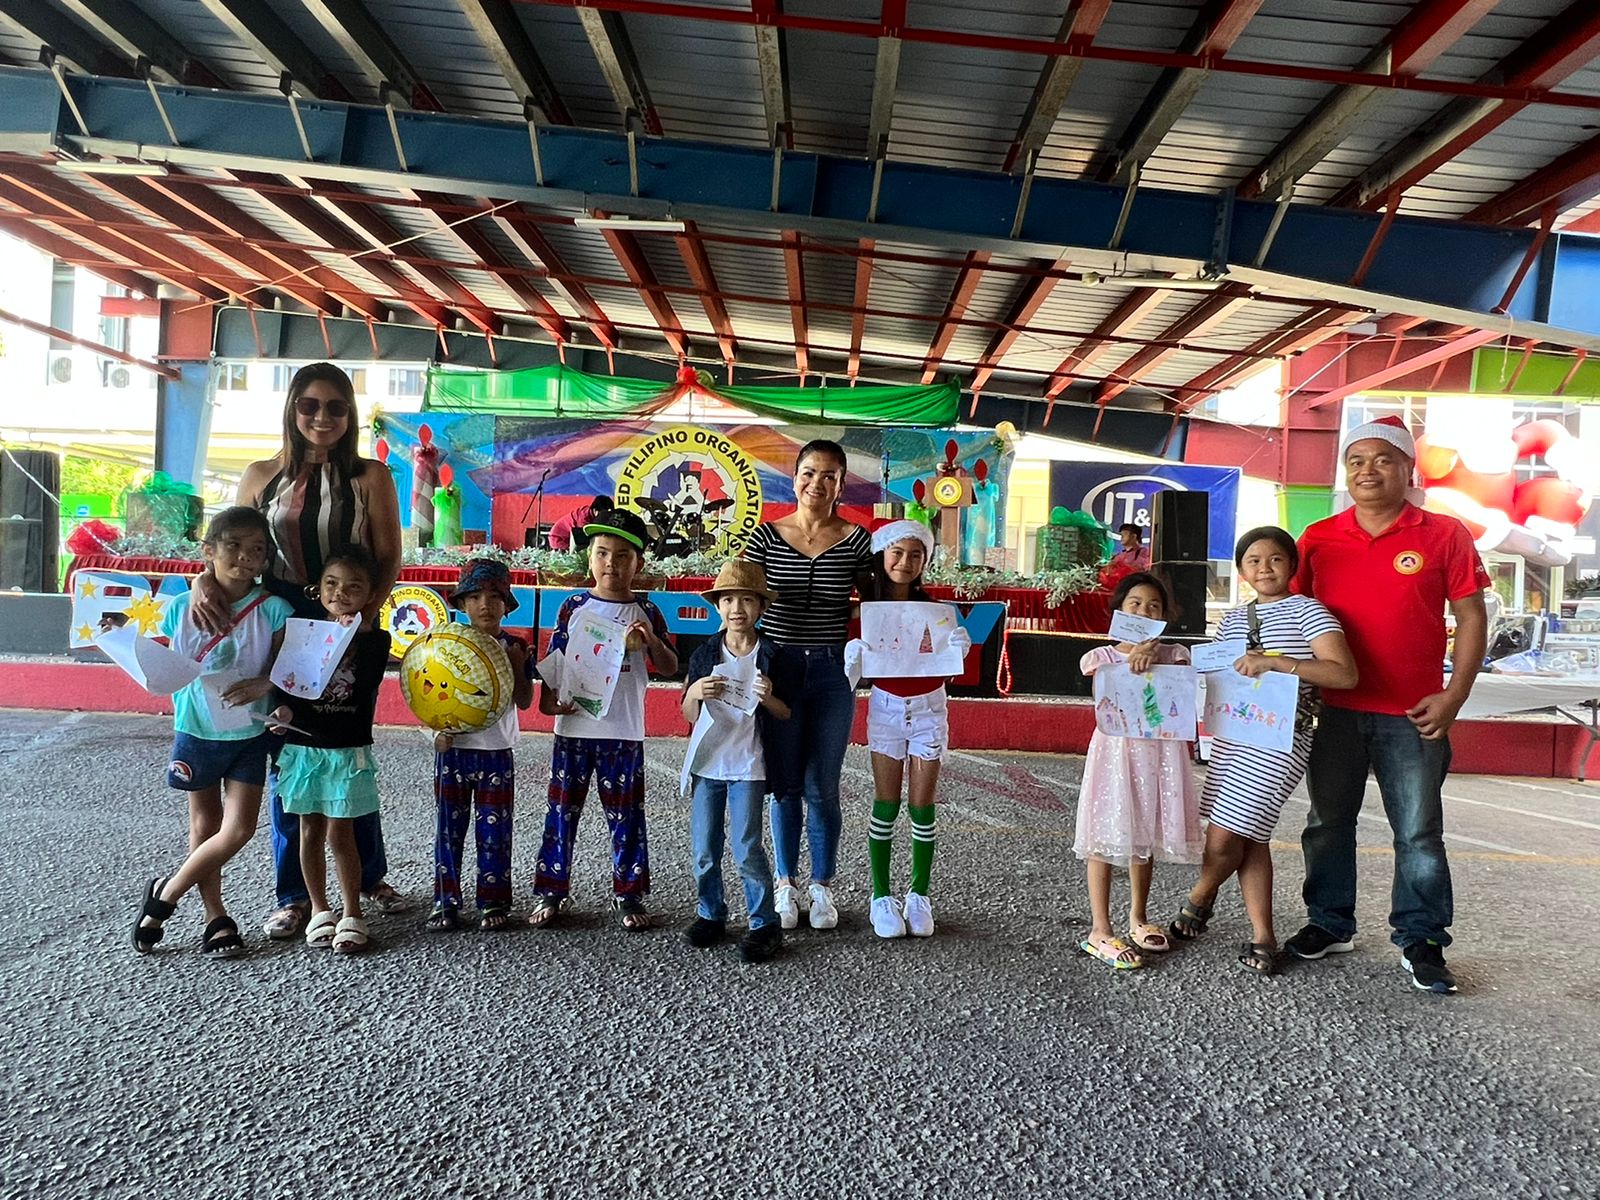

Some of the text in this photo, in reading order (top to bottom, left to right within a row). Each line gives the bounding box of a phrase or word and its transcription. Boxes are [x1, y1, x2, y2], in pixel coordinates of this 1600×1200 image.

[623, 430, 688, 480] FILIPINO
[694, 431, 759, 552] ORGANIZATIONS
[1105, 491, 1151, 527] IT&
[413, 588, 446, 625] ORGANIZA
